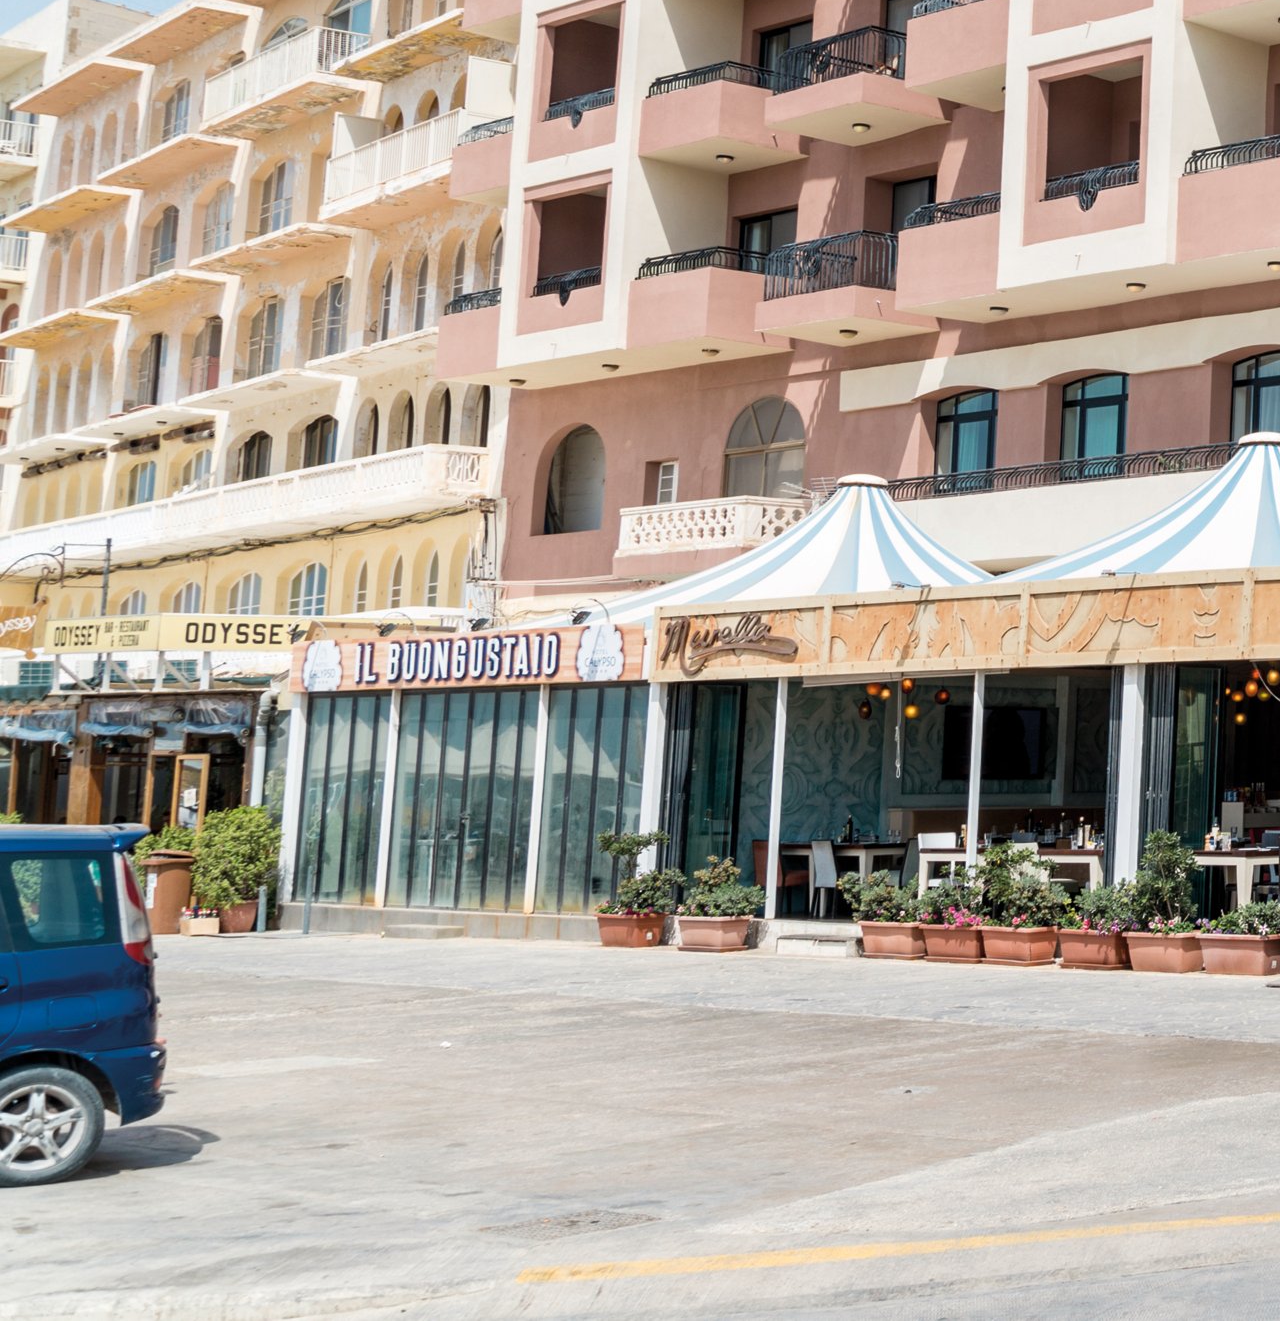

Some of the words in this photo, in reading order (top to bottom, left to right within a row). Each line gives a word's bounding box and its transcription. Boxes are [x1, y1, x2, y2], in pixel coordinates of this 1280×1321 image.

[54, 624, 102, 647] ODYSSEY
[354, 643, 378, 684] IL
[387, 631, 561, 682] BUONGUSTAIO
[584, 655, 617, 668] CALYPSO
